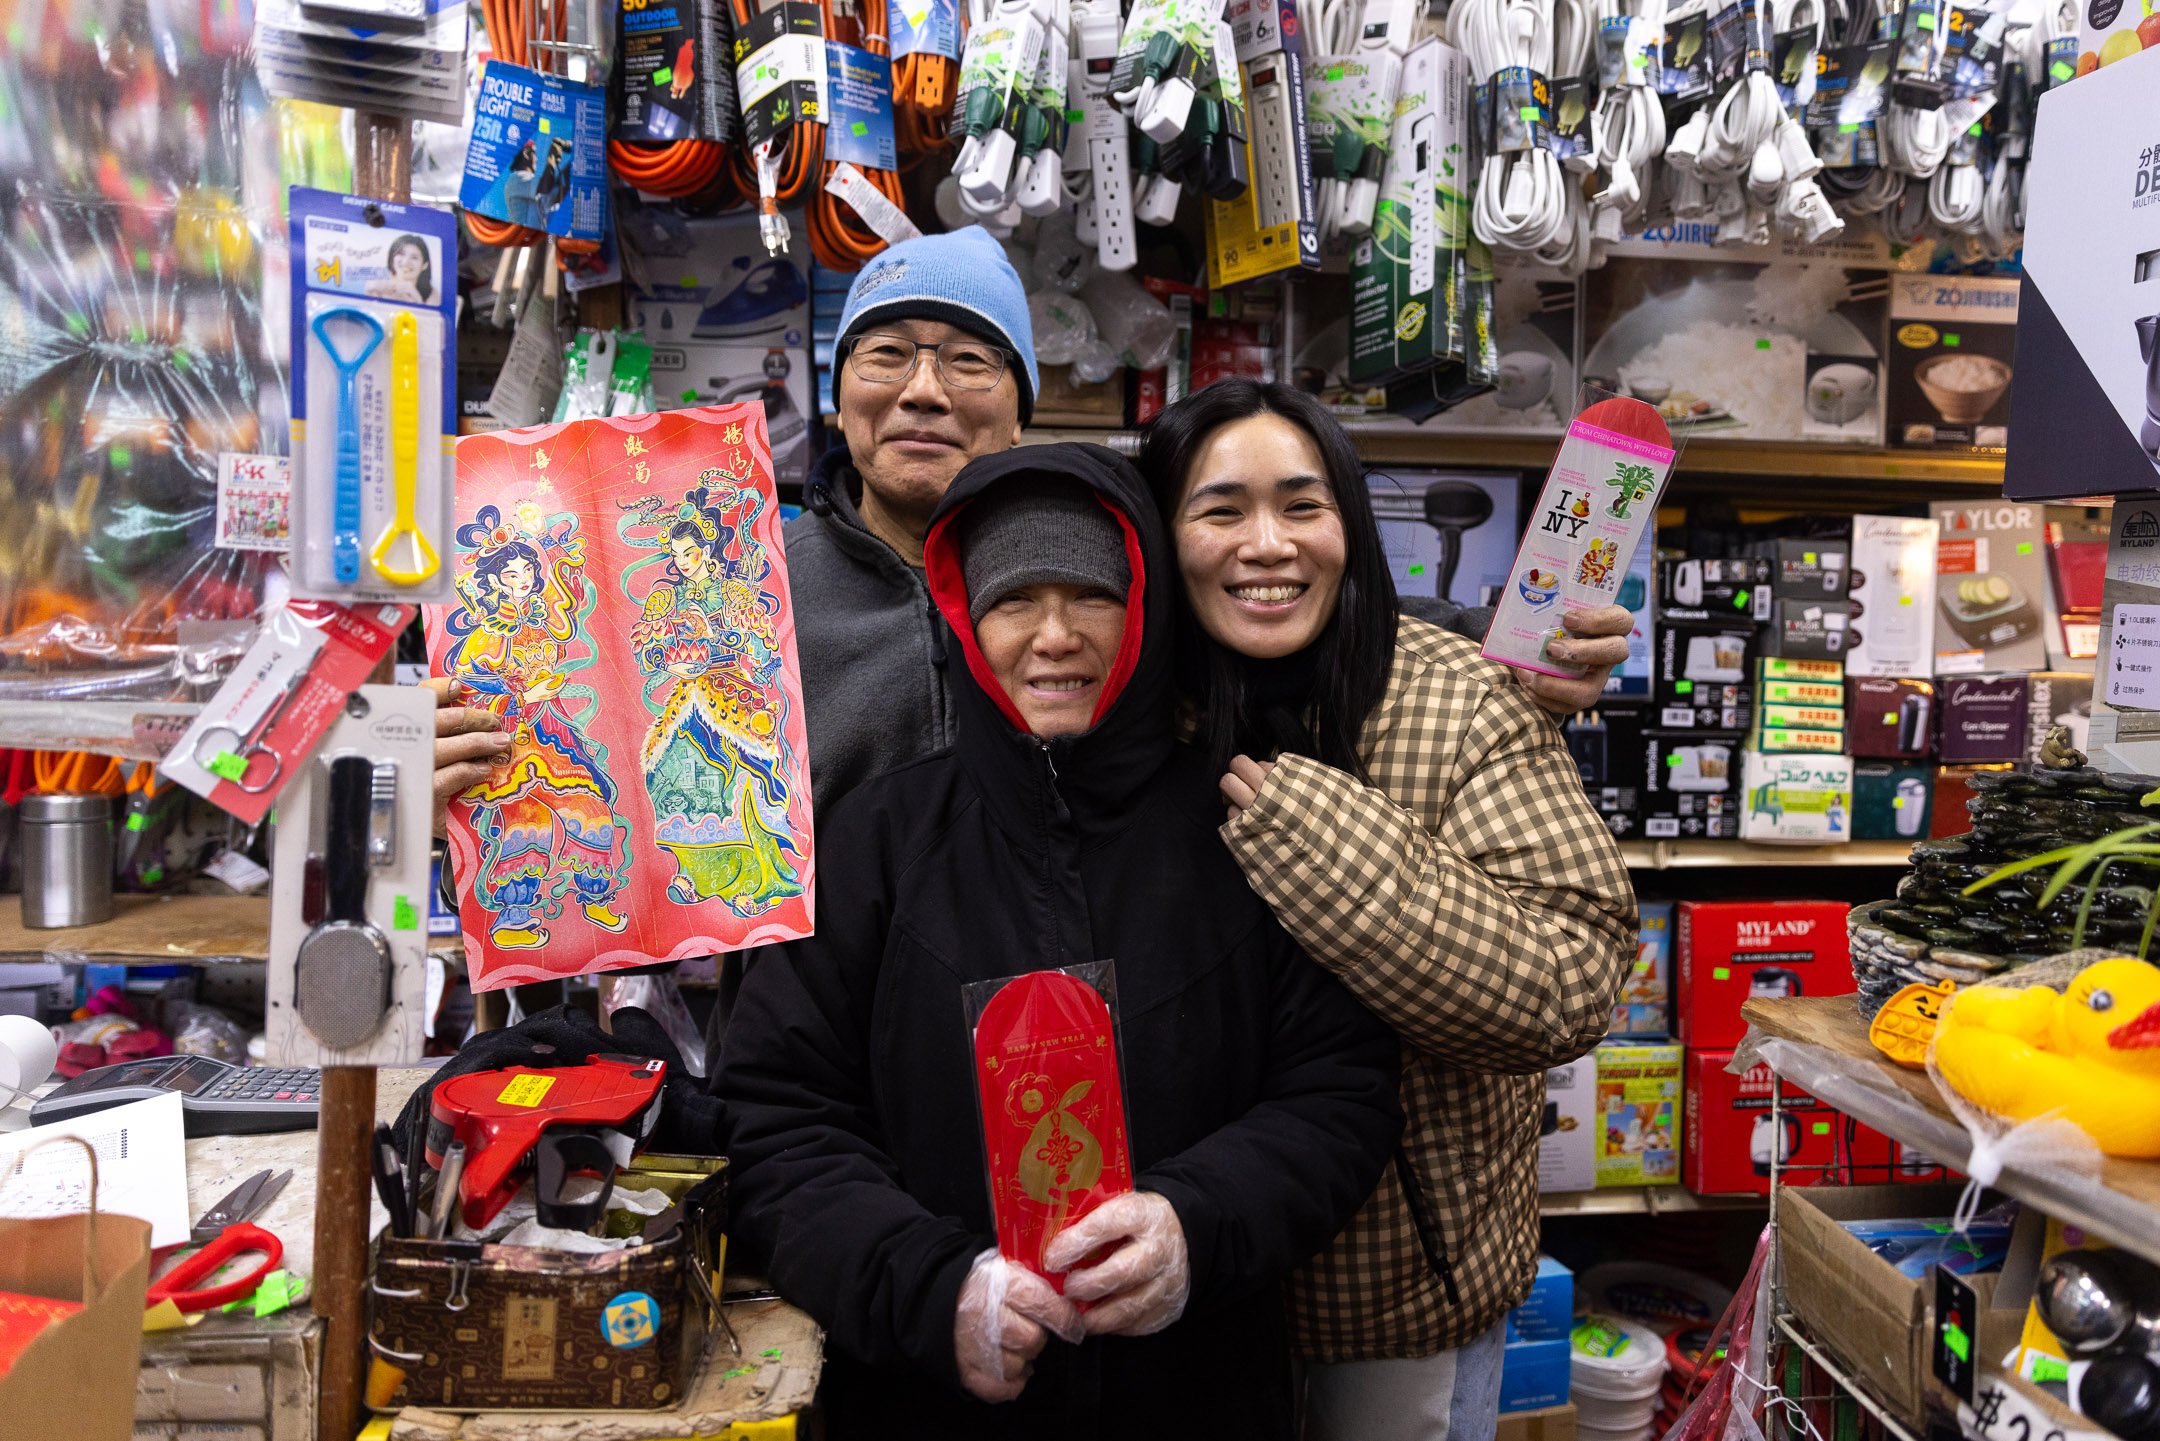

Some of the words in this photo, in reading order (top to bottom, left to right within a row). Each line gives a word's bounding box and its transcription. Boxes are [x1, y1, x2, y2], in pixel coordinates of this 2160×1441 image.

[624, 7, 677, 25] OUTDOOR
[2093, 4, 2117, 19] improved
[2096, 14, 2113, 26] design
[484, 76, 533, 106] TROUBLE
[479, 95, 512, 118] LIGHT
[801, 100, 819, 116] 25
[343, 196, 377, 208] DENT
[1573, 426, 1593, 437] FROM
[1593, 431, 1633, 448] CHINATOWN,
[1633, 443, 1651, 454] WITH
[1651, 449, 1669, 459] LOVE
[1555, 489, 1572, 510] I
[1542, 510, 1589, 538] NY
[1941, 507, 2033, 530] TAYLOR
[2120, 539, 2155, 548] MYLAND
[2127, 639, 2160, 648] 4片不锈钢刀
[1737, 920, 1810, 936] MYLAND
[1006, 1042, 1037, 1055] HAPPY
[1040, 1038, 1059, 1048] NEW
[1062, 1033, 1085, 1044] YEAR
